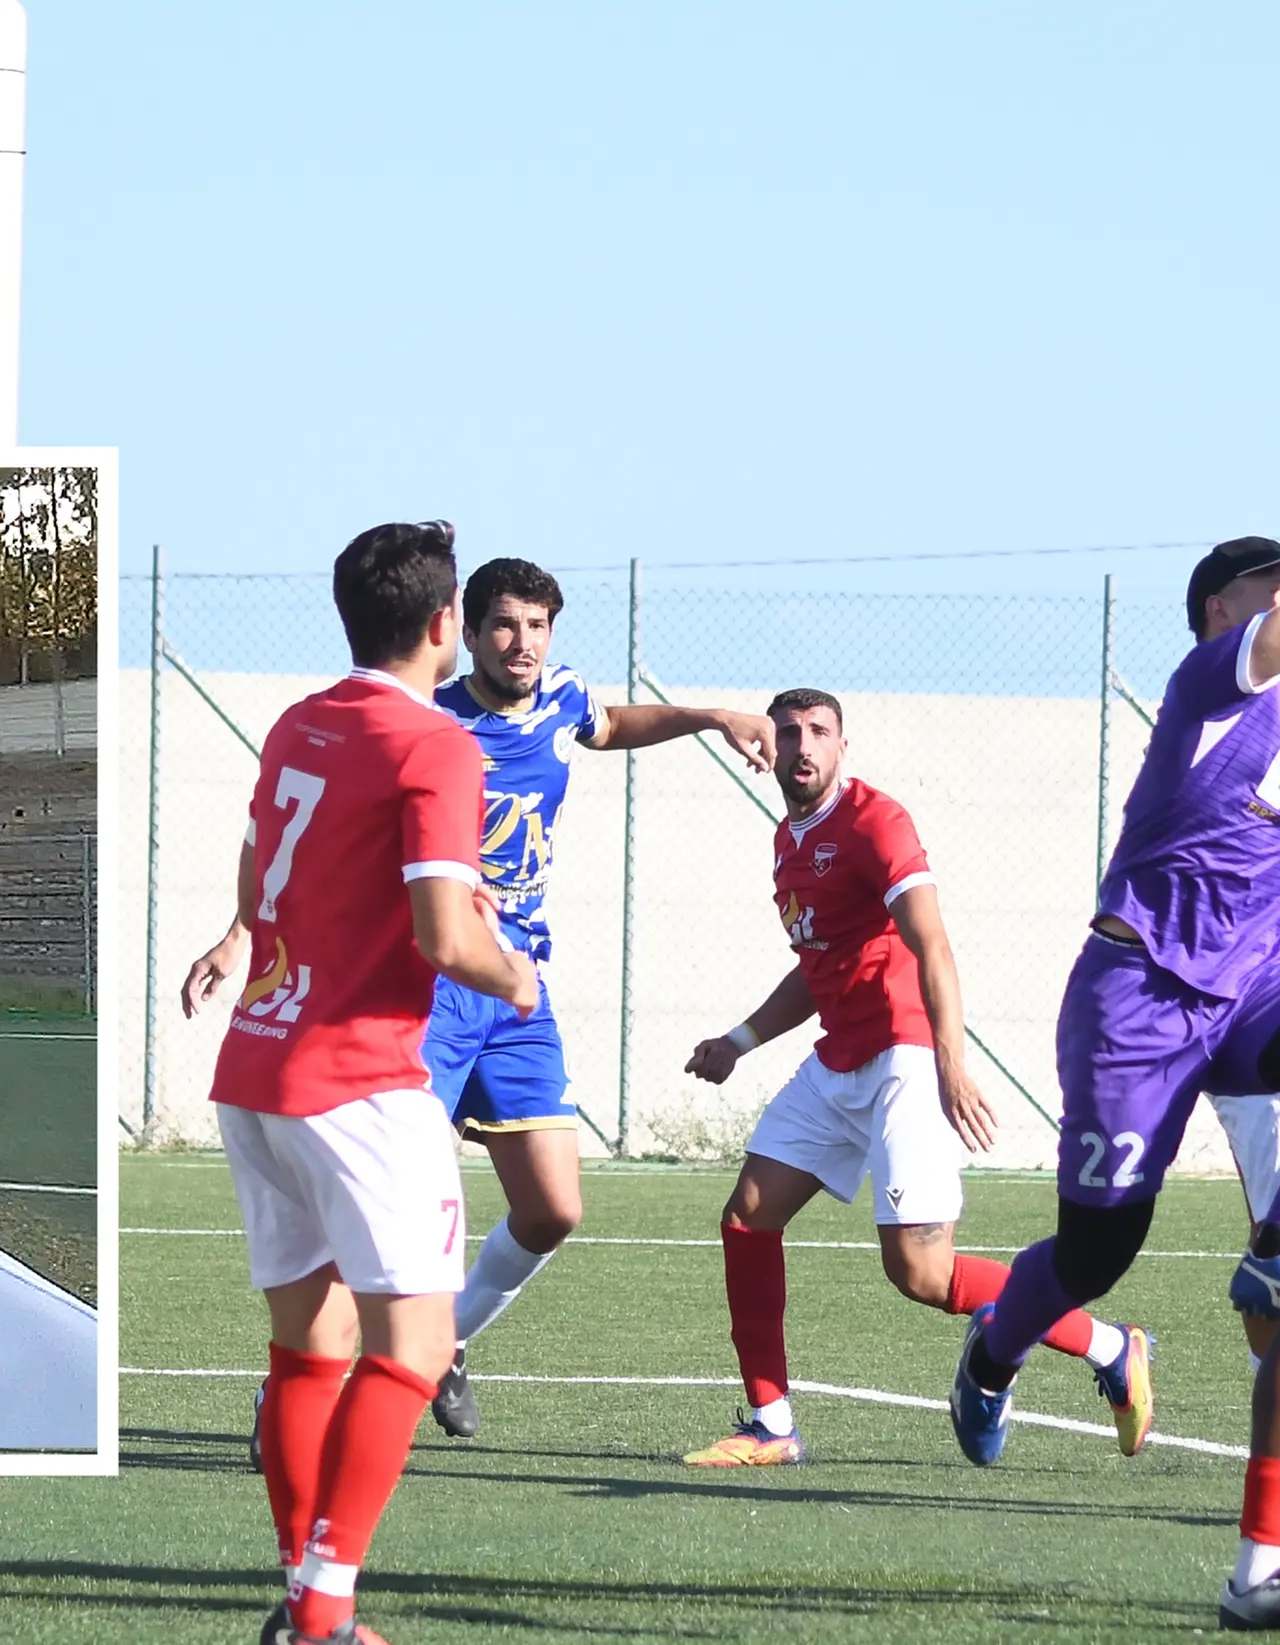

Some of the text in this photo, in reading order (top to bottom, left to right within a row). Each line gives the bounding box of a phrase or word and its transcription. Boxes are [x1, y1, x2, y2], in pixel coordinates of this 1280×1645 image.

[258, 766, 326, 923] 7
[1078, 1131, 1145, 1188] 22
[441, 1199, 458, 1256] 7
